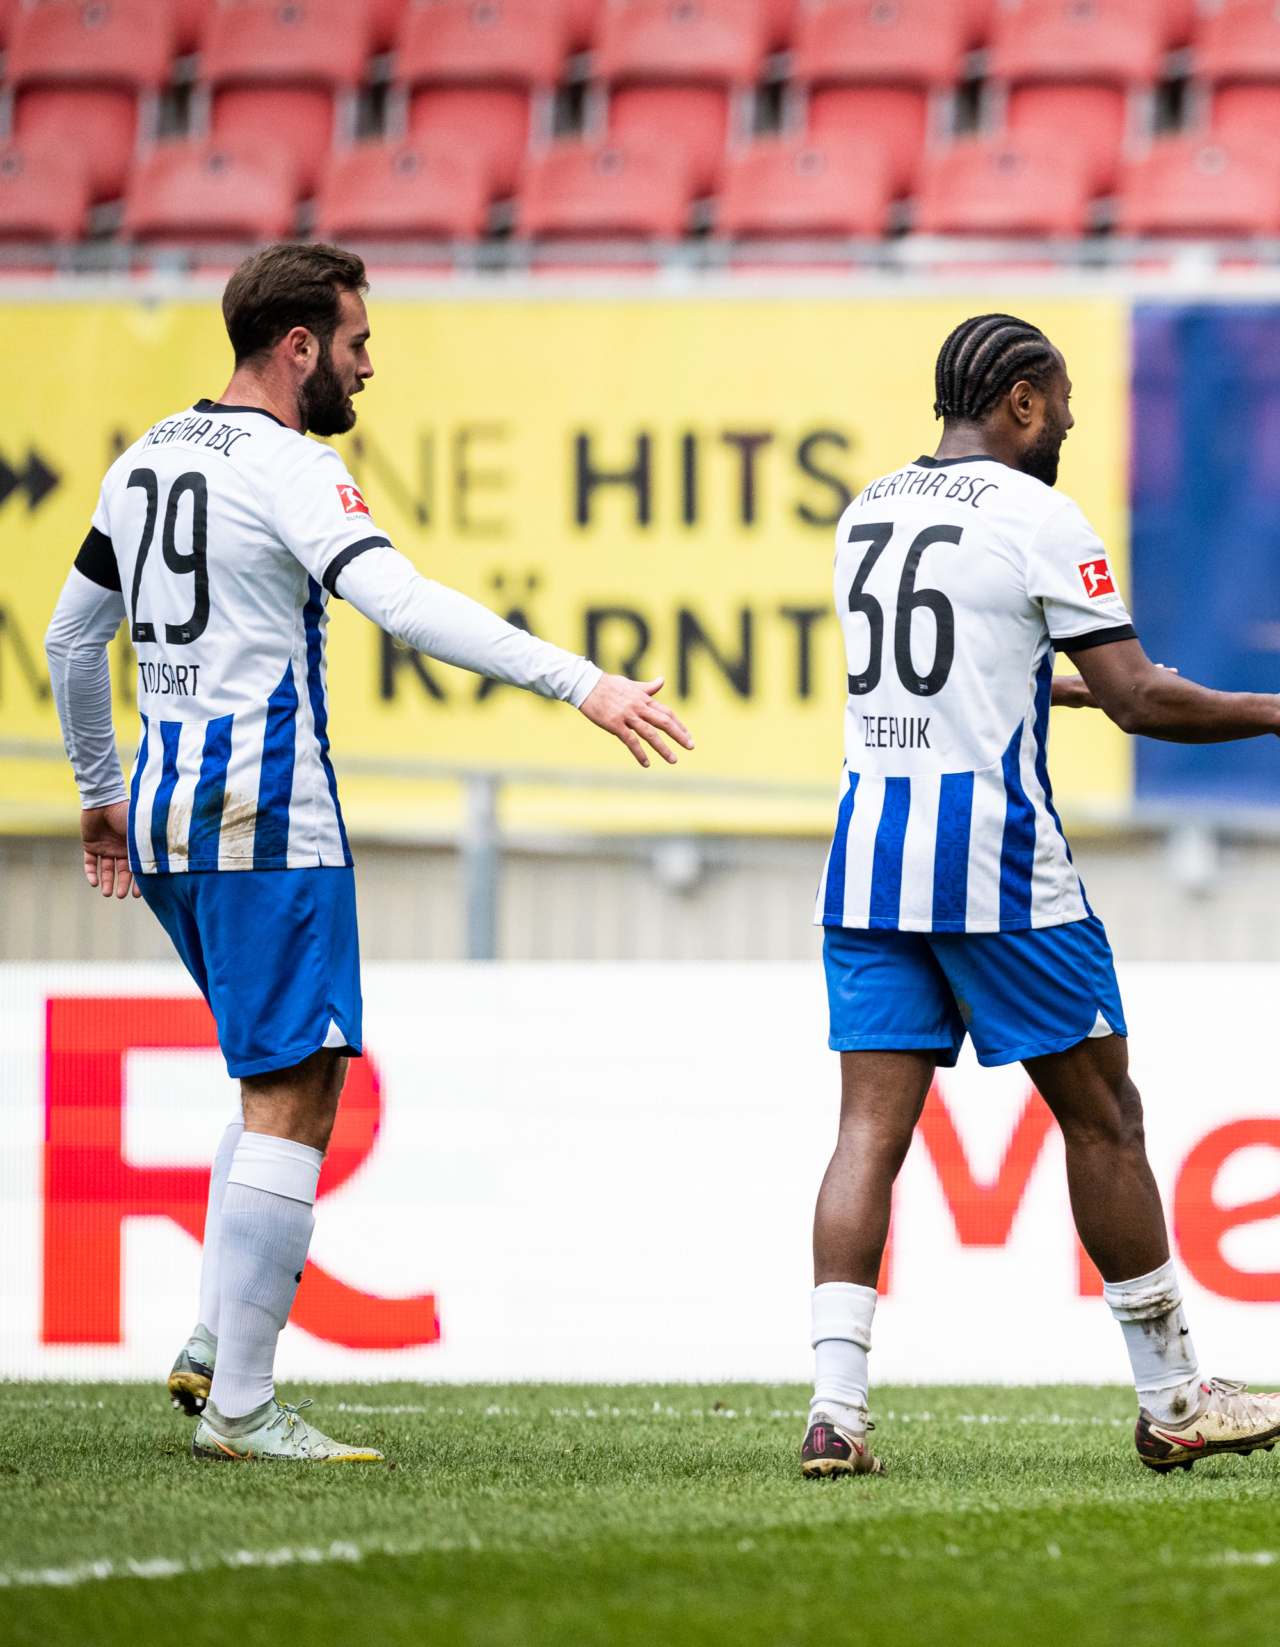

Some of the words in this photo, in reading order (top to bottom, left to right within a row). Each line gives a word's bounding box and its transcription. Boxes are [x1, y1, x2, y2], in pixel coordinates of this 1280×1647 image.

[142, 416, 213, 450] HERTHA
[205, 423, 251, 457] BSC
[571, 424, 856, 530] HITS
[860, 470, 948, 507] HERTHA
[945, 475, 999, 508] BSC
[126, 467, 209, 645] 29
[847, 521, 964, 697] 36
[862, 715, 931, 749] ZEEFUIK
